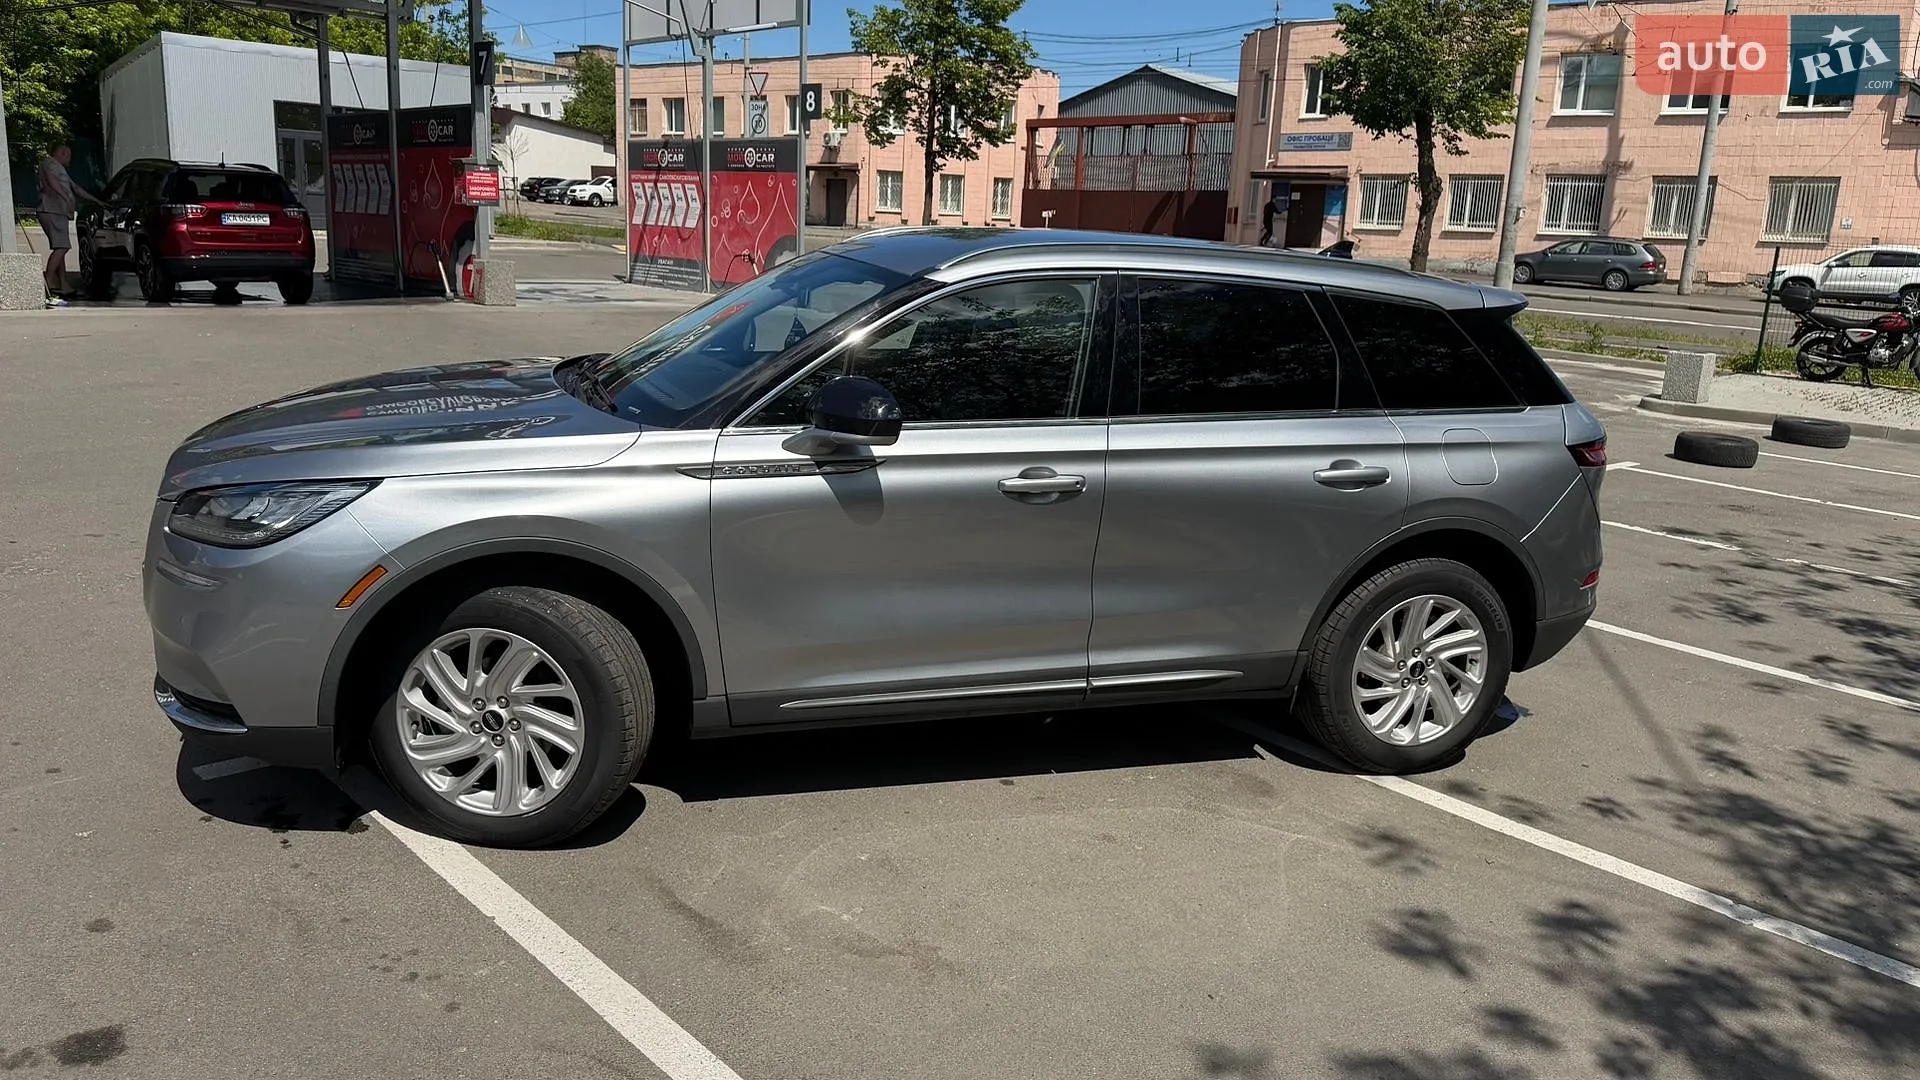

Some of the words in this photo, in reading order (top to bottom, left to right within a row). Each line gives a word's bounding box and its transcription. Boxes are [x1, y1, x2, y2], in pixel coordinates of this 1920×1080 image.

[478, 50, 488, 75] 7
[806, 90, 815, 112] 8
[438, 125, 453, 135] CAR
[756, 153, 775, 162] CAR
[722, 464, 801, 475] CORSAIR
